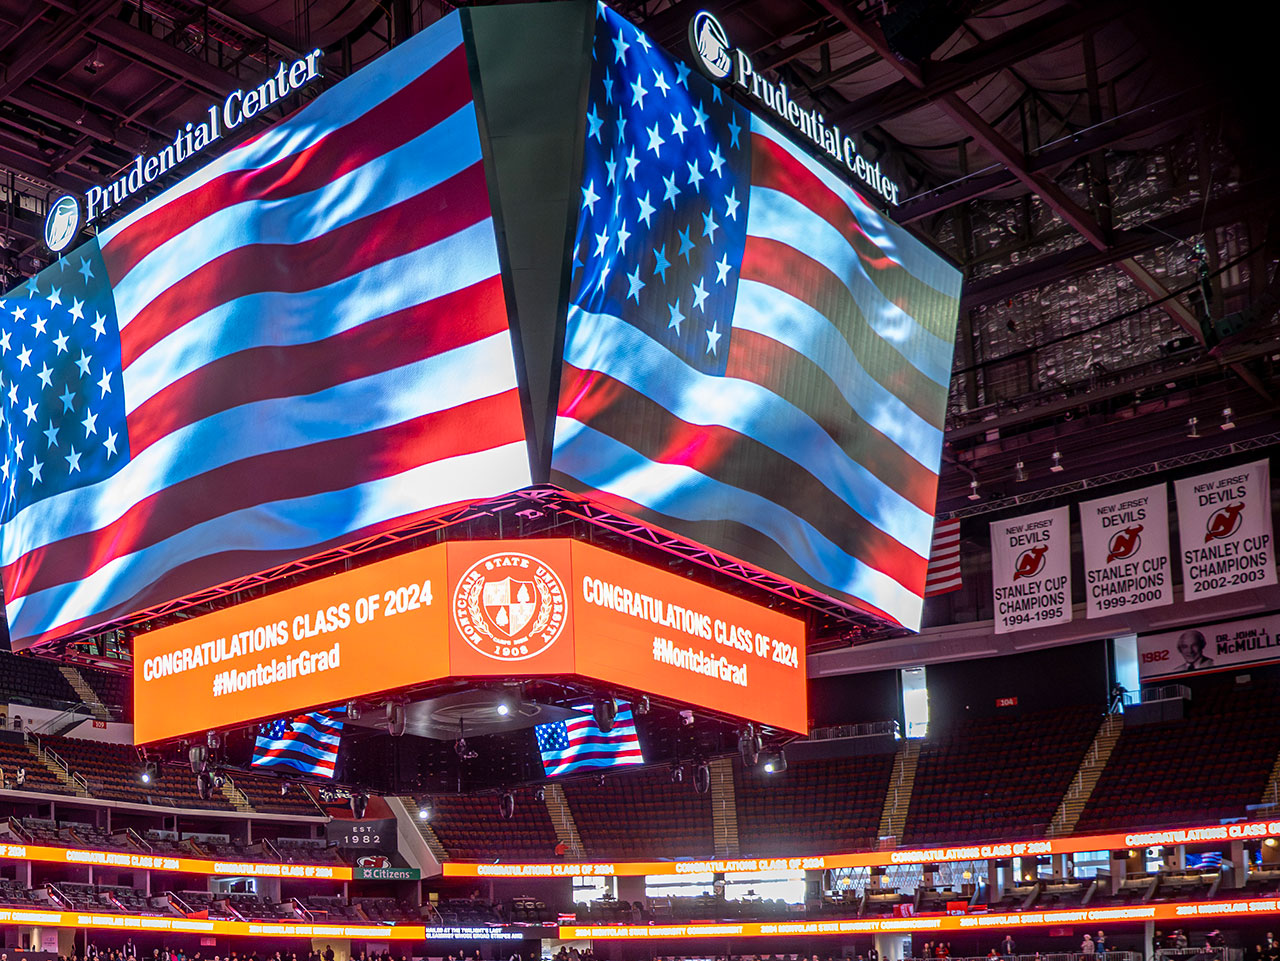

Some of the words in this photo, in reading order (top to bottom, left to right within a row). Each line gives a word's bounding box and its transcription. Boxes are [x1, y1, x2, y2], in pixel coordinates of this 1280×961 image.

[85, 104, 220, 225] Prudential
[223, 48, 324, 130] Center
[736, 47, 845, 163] Prudential
[844, 136, 900, 207] Center
[1194, 480, 1215, 495] NEW
[1216, 473, 1250, 491] JERSEY
[1097, 503, 1117, 516] NEW
[1117, 496, 1149, 512] JERSEY
[1198, 486, 1247, 507] DEVILS
[1006, 523, 1023, 535] NEW
[1024, 519, 1053, 532] JERSEY
[1102, 508, 1146, 528] DEVILS
[1009, 530, 1051, 548] DEVILS
[1184, 541, 1240, 566] STANLEY
[1243, 534, 1270, 552] CUP
[1087, 561, 1140, 584] STANLEY
[1142, 556, 1168, 574] CUP
[1189, 552, 1268, 581] CHAMPIONS
[995, 581, 1043, 601] STANLEY
[1044, 575, 1068, 592] CUP
[1092, 573, 1165, 599] CHAMPIONS
[1193, 569, 1266, 593] 2002-2003
[457, 570, 483, 645] MONTCLAIR
[484, 557, 530, 571] STATE
[535, 565, 563, 643] UNIVERSITY
[999, 592, 1065, 615] CHAMPIONS
[1096, 589, 1162, 612] 1999-2000
[582, 576, 712, 641] CONGRATULATIONS
[714, 619, 754, 654] CLASS
[755, 633, 770, 659] OF
[772, 640, 799, 669] 2024
[1002, 608, 1063, 627] 1994-1995
[142, 619, 289, 682] CONGRATULATIONS
[292, 602, 351, 641] CLASS
[355, 594, 379, 622] OF
[384, 579, 433, 618] 2024
[1216, 633, 1231, 643] DR.
[1233, 629, 1257, 641] JOHN
[1258, 628, 1268, 637] J.
[494, 645, 529, 657] 1908
[652, 636, 748, 687] #MontclairGrad
[1141, 649, 1170, 664] 1982
[212, 642, 340, 698] #MontclairGrad
[344, 834, 381, 844] 1982
[1229, 823, 1267, 838] CLASS
[373, 868, 411, 879] Citizens
